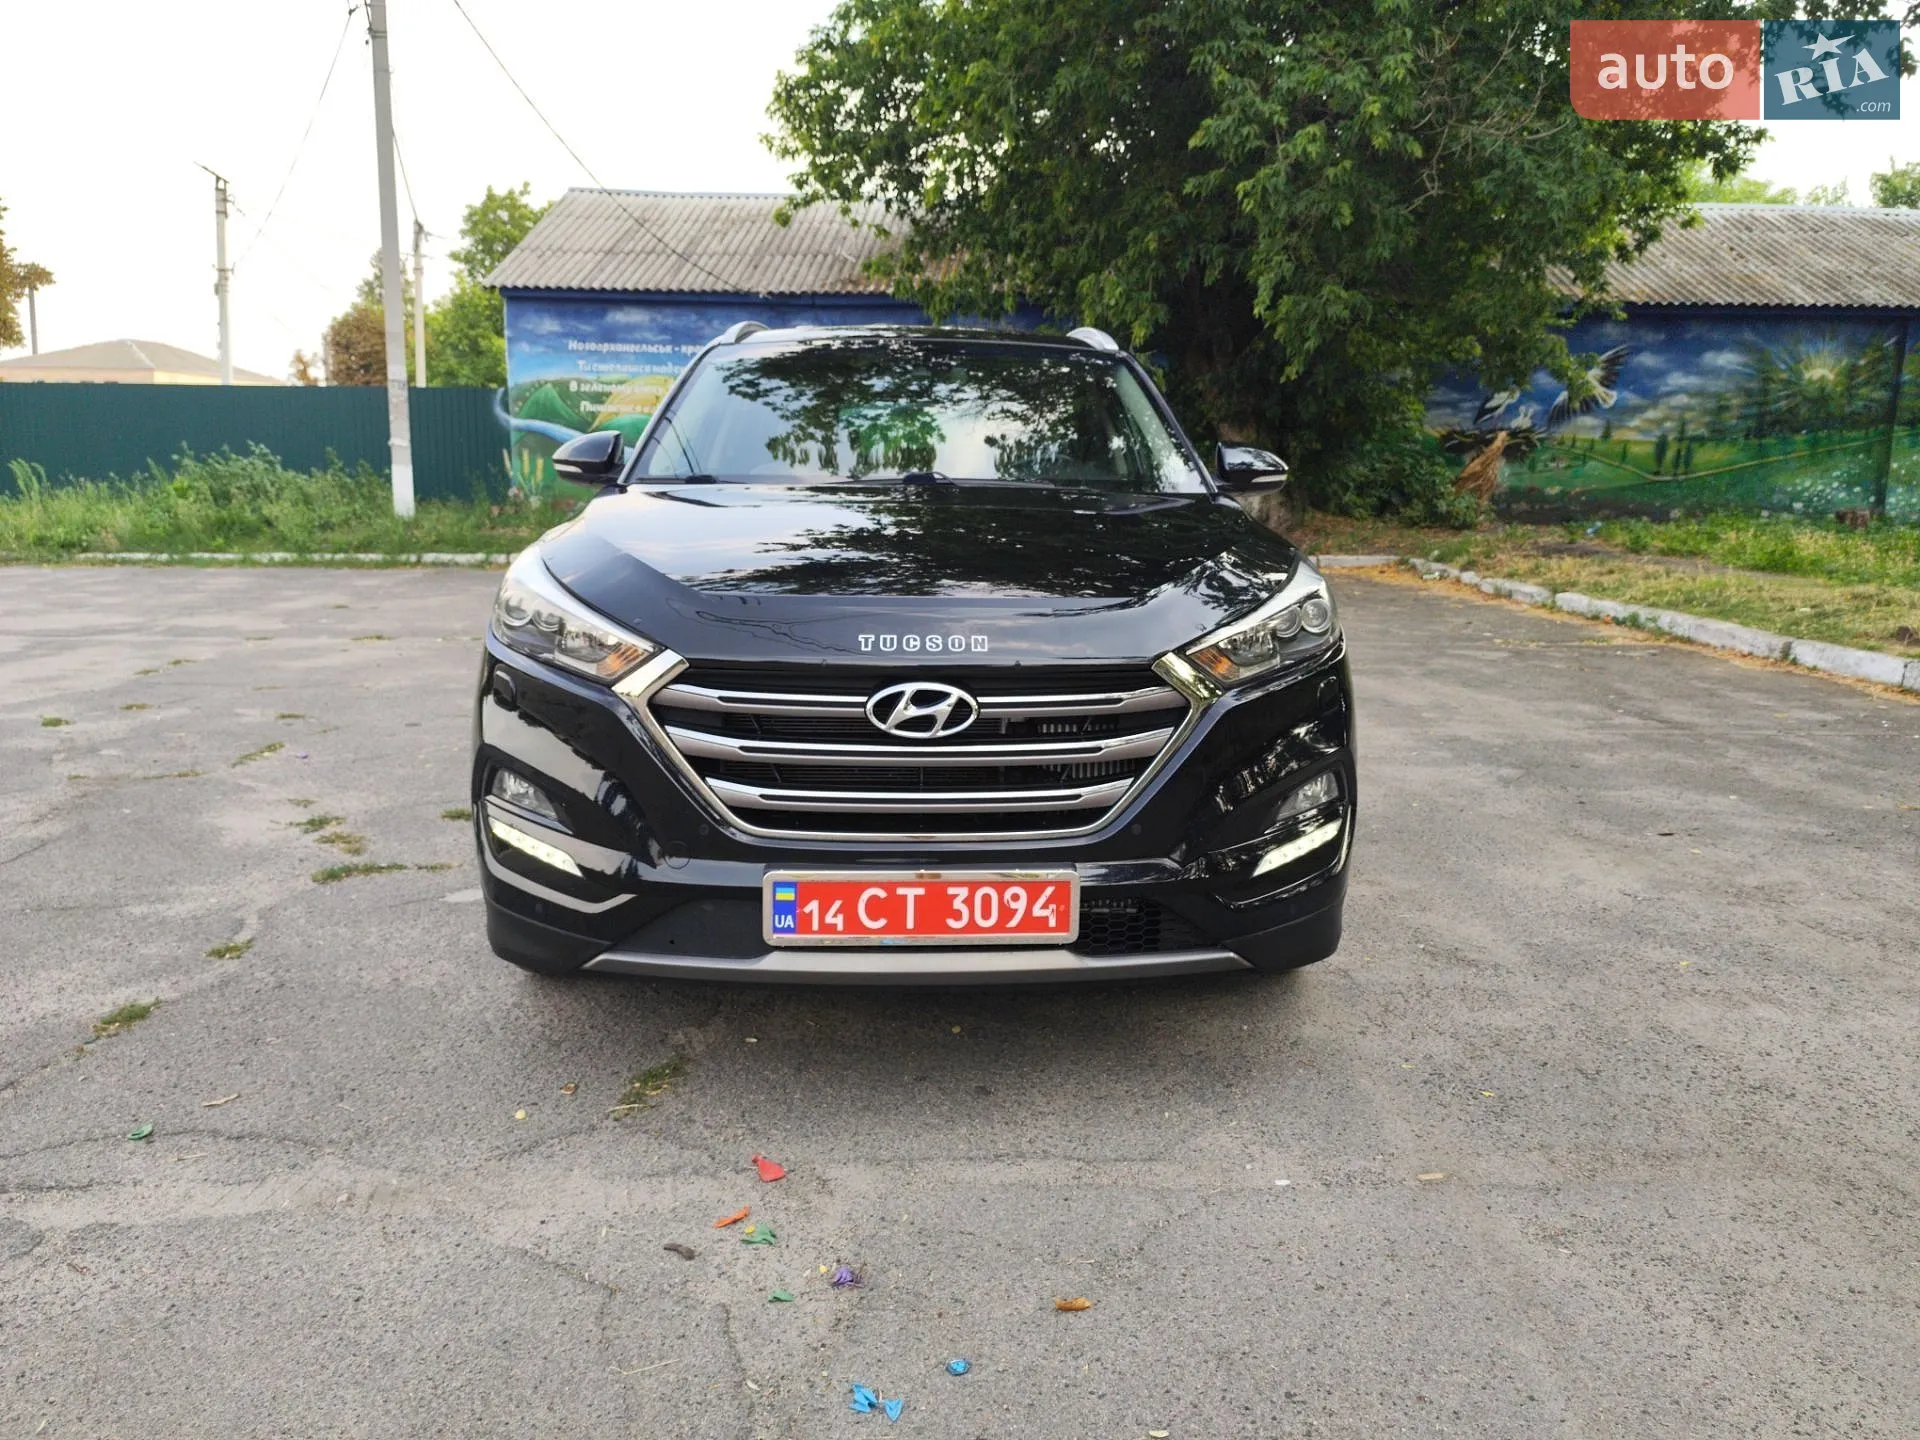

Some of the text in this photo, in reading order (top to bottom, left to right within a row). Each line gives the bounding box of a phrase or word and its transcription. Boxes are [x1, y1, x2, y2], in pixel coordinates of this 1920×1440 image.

[857, 633, 989, 652] TUCSON
[802, 886, 1056, 931] 14 CT 3094
[774, 914, 795, 929] UA
